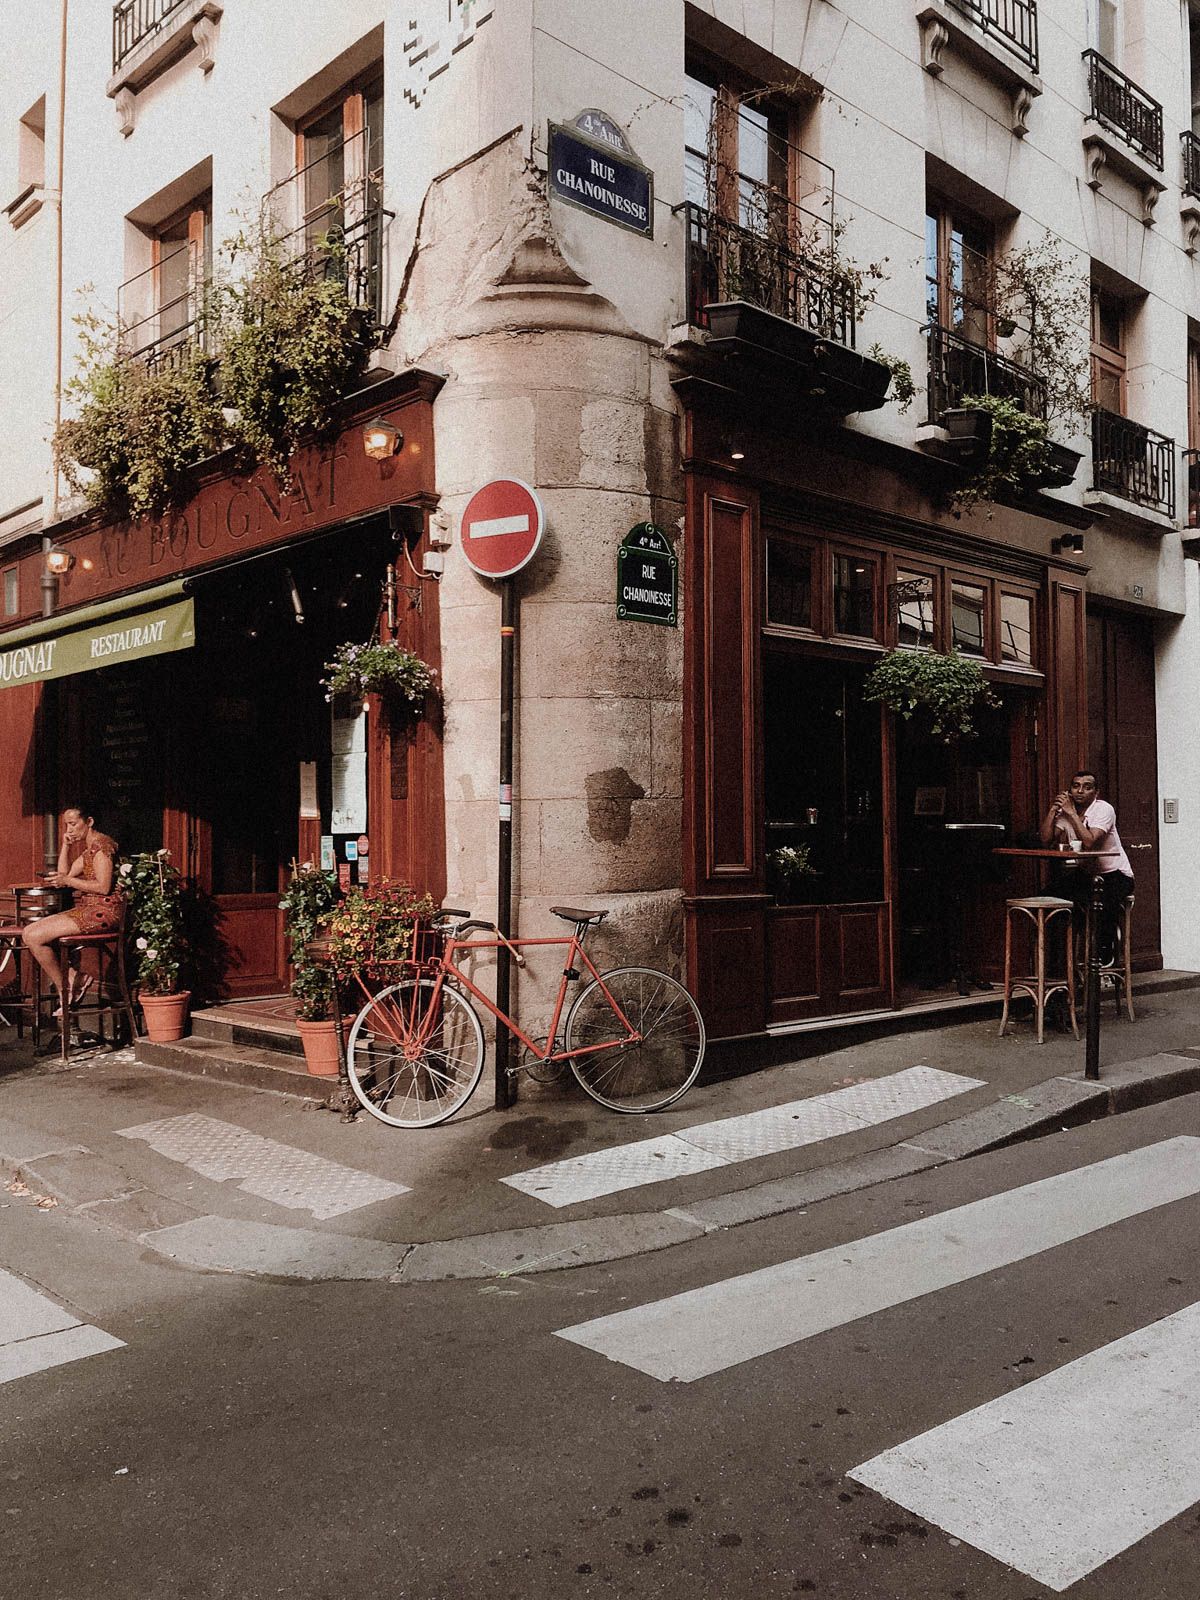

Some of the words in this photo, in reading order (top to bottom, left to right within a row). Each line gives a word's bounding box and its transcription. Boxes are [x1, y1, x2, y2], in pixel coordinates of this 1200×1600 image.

[590, 158, 615, 183] RUE
[557, 169, 647, 221] CHANOINESSE
[642, 564, 656, 580] RUE
[623, 586, 671, 607] CHANOINESSE
[0, 640, 57, 682] UGNAT
[90, 620, 167, 659] RESTAURANT
